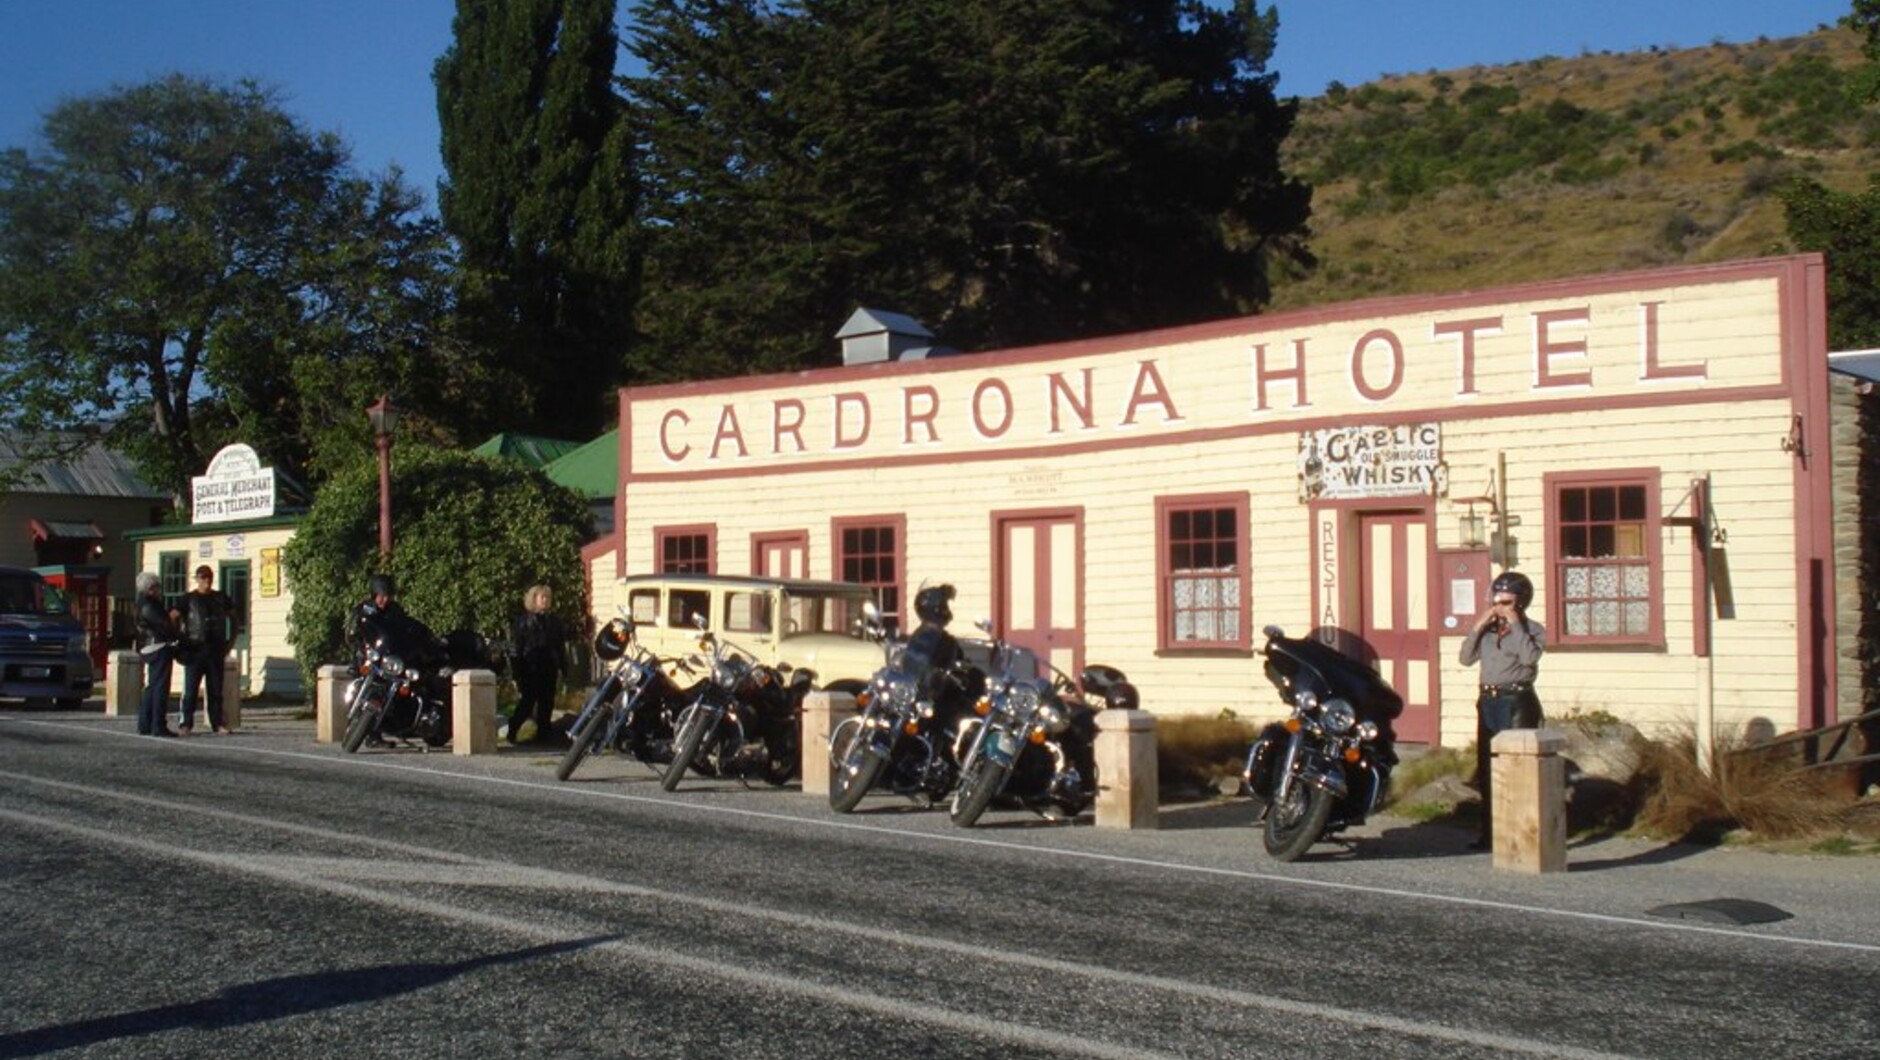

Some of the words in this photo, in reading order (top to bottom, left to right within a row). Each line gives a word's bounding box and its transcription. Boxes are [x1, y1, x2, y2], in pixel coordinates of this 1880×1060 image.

[659, 358, 1186, 463] CARDRONA
[1251, 301, 1708, 412] HOTEL
[1326, 428, 1436, 463] GAELIC
[196, 482, 229, 501] GENERAL
[231, 477, 272, 498] MERCHANT
[1342, 465, 1438, 486] WHISKY
[196, 501, 216, 518] POST
[224, 495, 271, 515] TELEGRAPH
[1322, 521, 1336, 645] RESTAU
